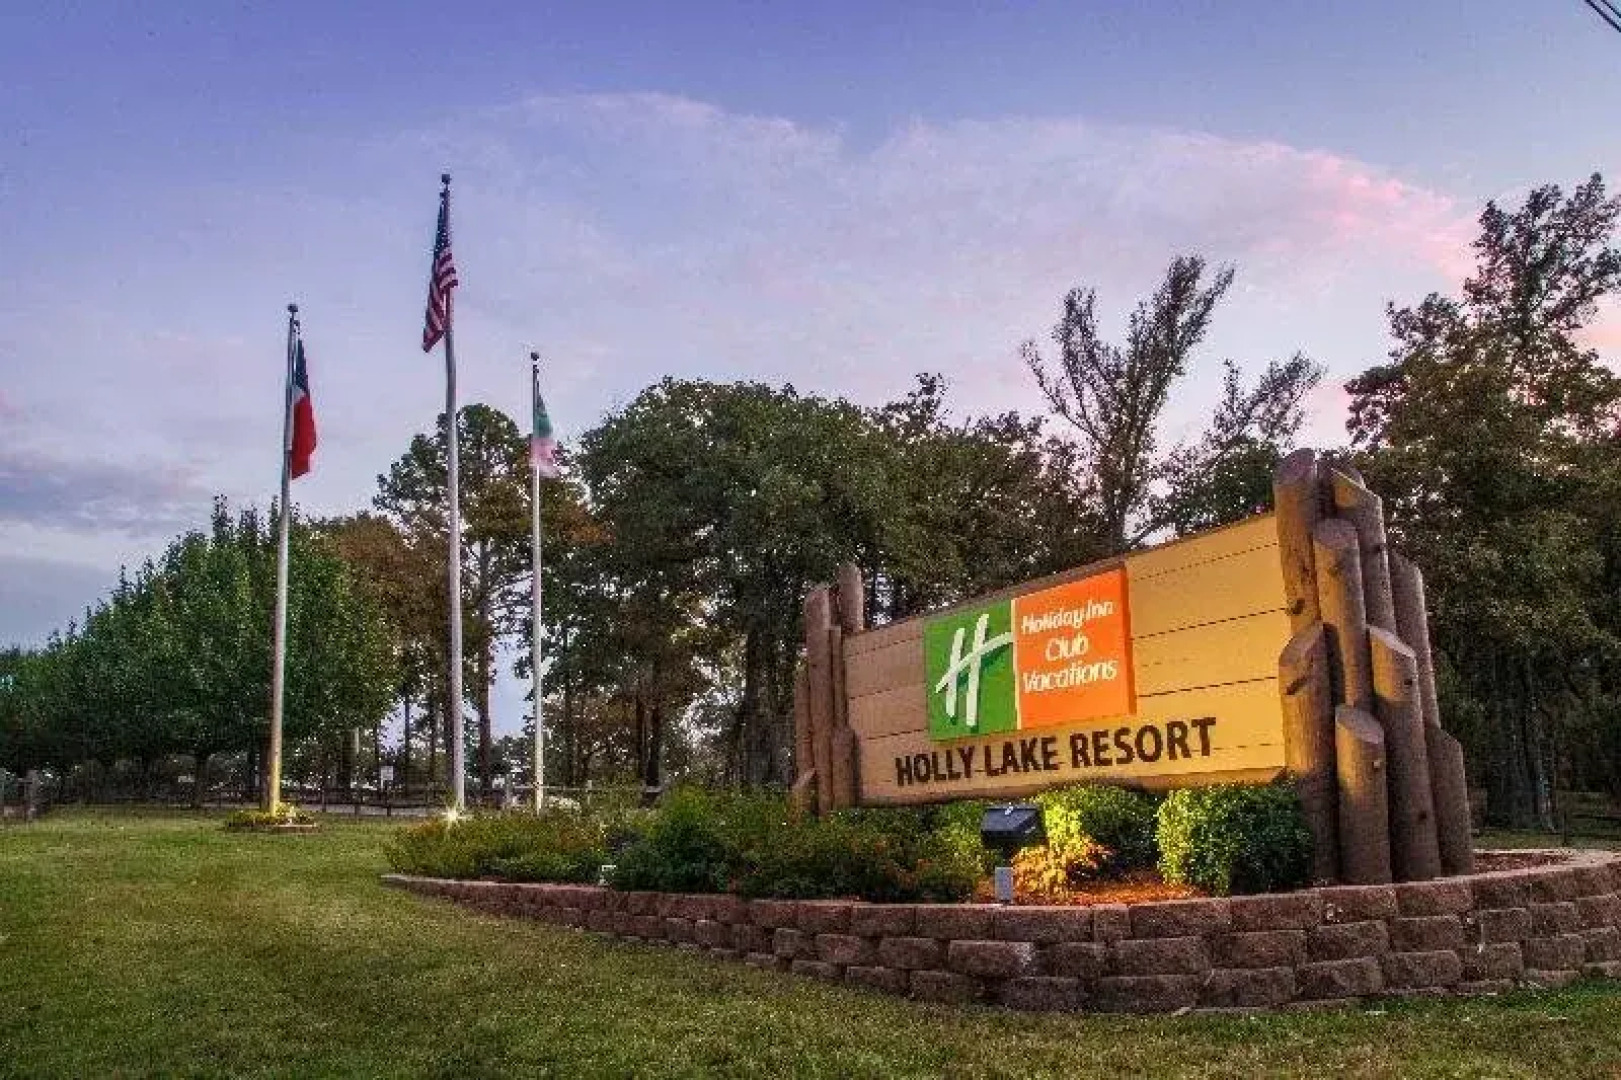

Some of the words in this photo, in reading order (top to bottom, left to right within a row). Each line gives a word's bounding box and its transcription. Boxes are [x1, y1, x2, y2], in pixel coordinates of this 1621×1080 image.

[1021, 608, 1085, 634] Holiday
[1086, 600, 1113, 621] Inn
[1045, 633, 1089, 661] Club
[1022, 660, 1118, 693] Vacations
[895, 746, 975, 787] HOLLY
[984, 736, 1061, 777] LAKE
[1069, 717, 1217, 769] RESORT
